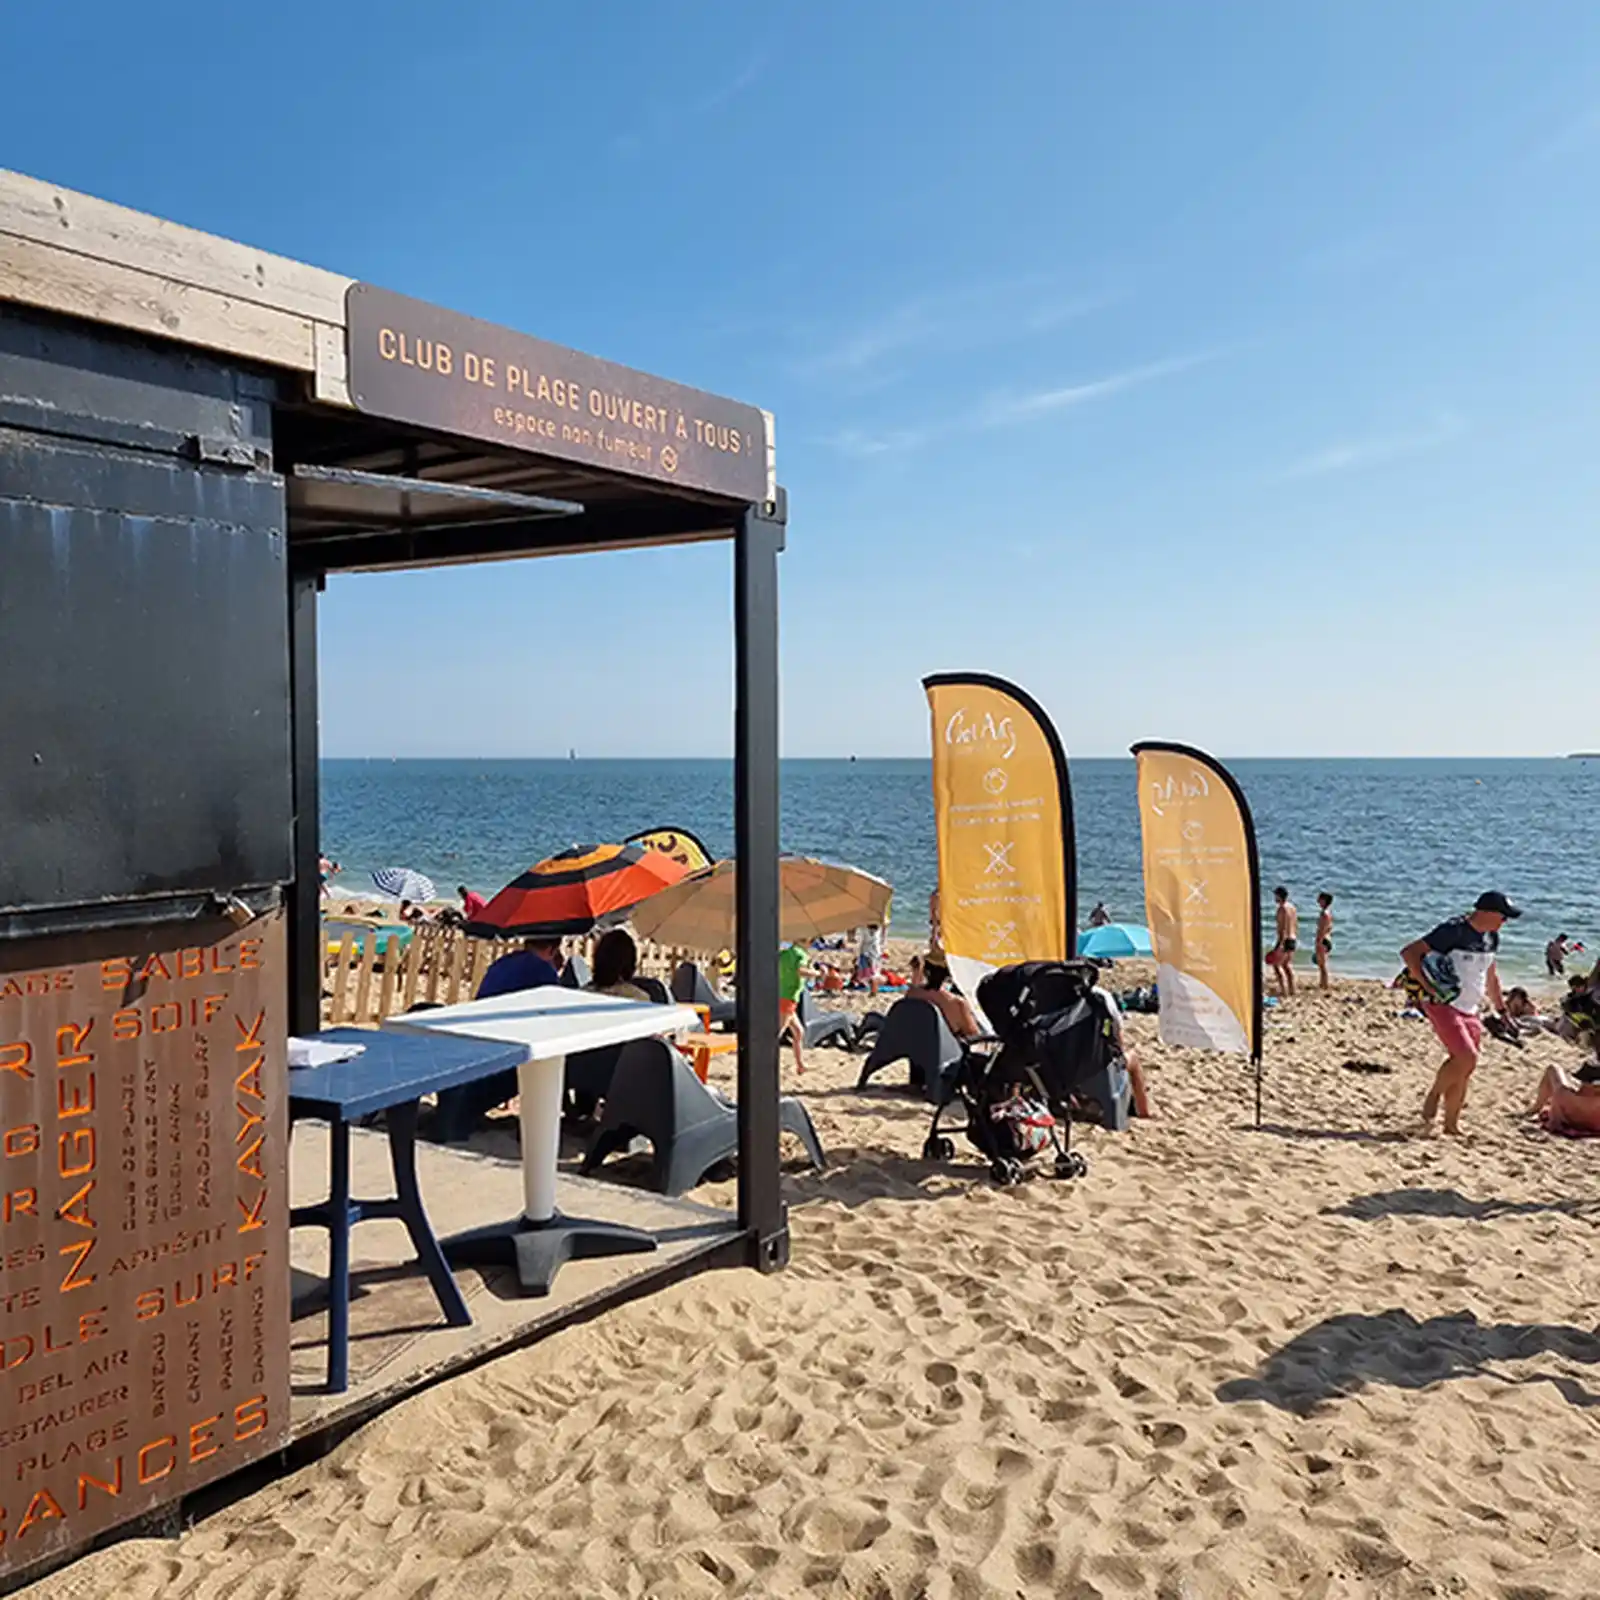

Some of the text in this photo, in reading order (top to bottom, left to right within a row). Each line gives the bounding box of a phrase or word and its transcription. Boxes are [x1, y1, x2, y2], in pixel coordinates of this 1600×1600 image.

[378, 327, 453, 375] CLUB
[464, 351, 496, 388] DE
[506, 364, 580, 411] PLAGE
[589, 389, 667, 434] OUVERT
[694, 417, 741, 453] TOUS
[0, 969, 75, 999] AGE
[101, 937, 264, 990] SABLE
[112, 993, 229, 1040] SOIF
[234, 1006, 268, 1234] KAYAK
[54, 1016, 96, 1293] NAGER
[134, 1249, 268, 1321] SURF
[18, 1349, 129, 1404] BEL AIR
[0, 1394, 269, 1546] ANCES
[16, 1418, 129, 1482] PLAGE
